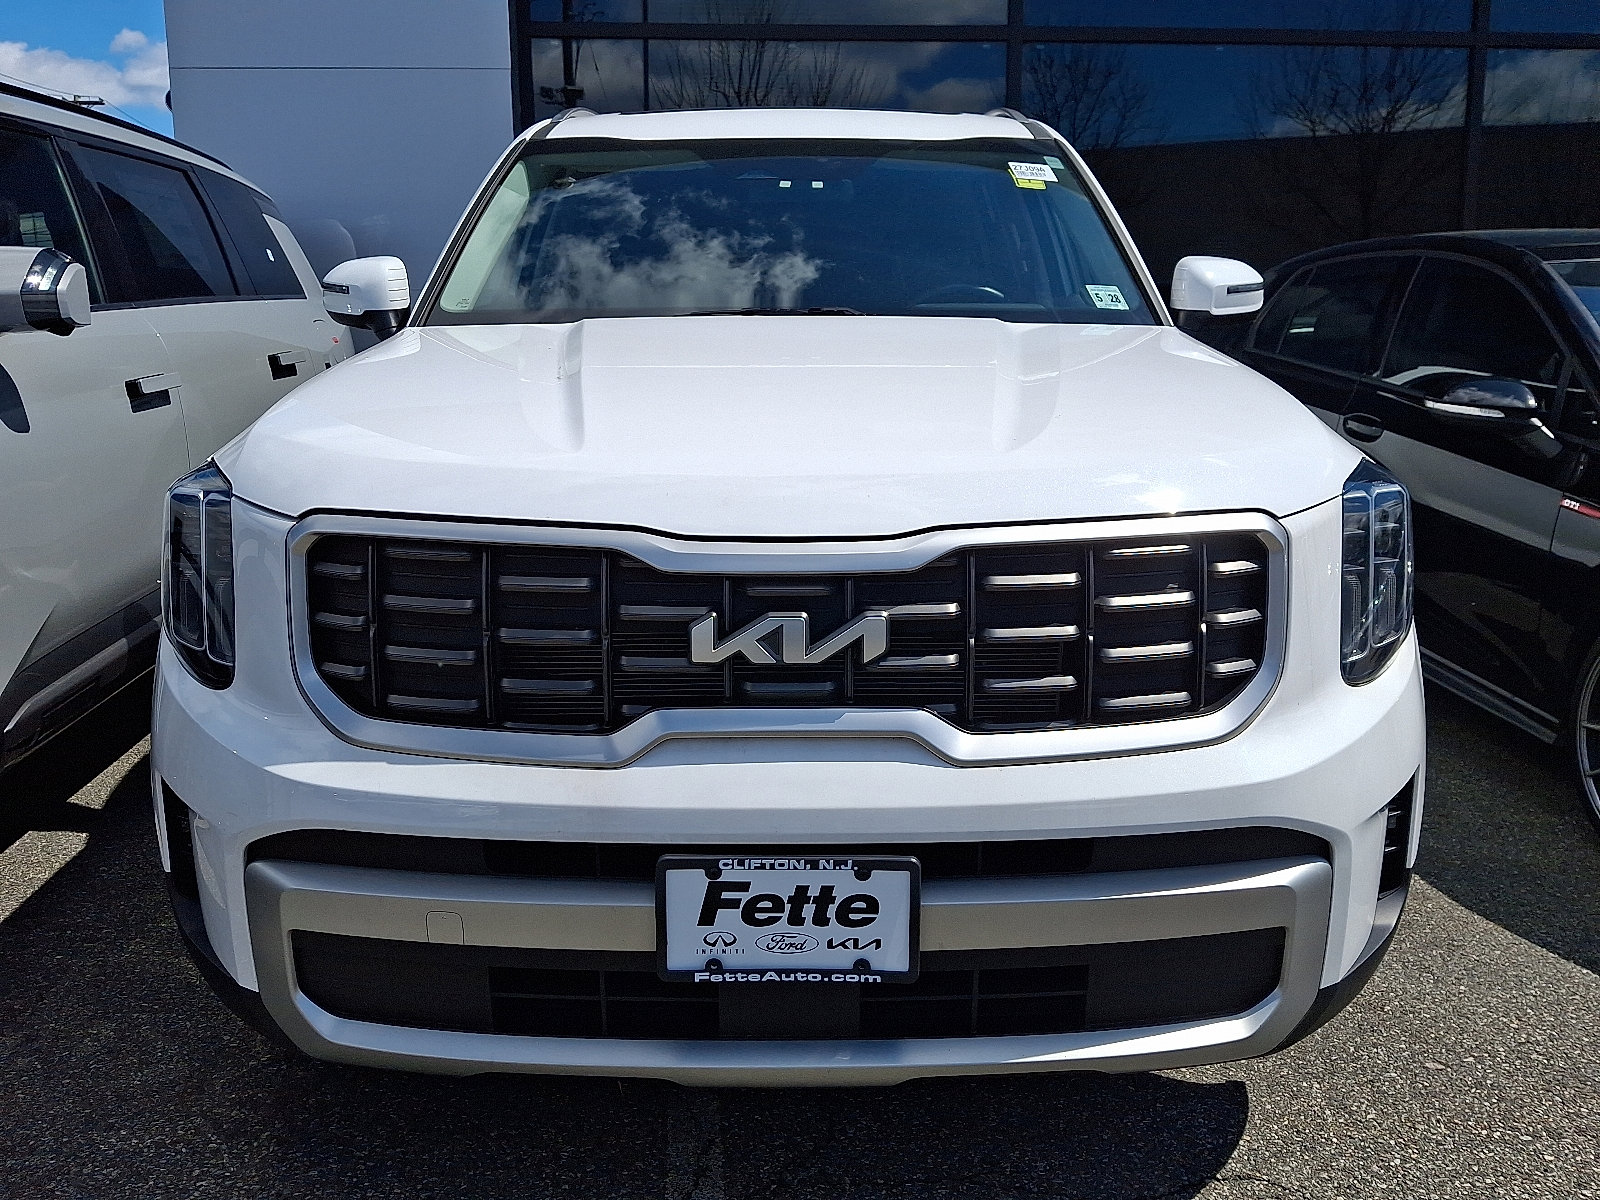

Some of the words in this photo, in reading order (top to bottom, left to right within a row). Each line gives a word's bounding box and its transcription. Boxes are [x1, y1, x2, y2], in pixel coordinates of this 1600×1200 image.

[1094, 292, 1104, 302] 5
[1107, 293, 1122, 303] 28
[689, 611, 889, 664] KIA
[719, 858, 811, 871] CLIFTON,
[819, 859, 859, 870] N.J.
[696, 880, 880, 928] Fette
[766, 934, 808, 951] Ford
[826, 937, 882, 950] KIA
[694, 972, 882, 983] FetteAuto.com
